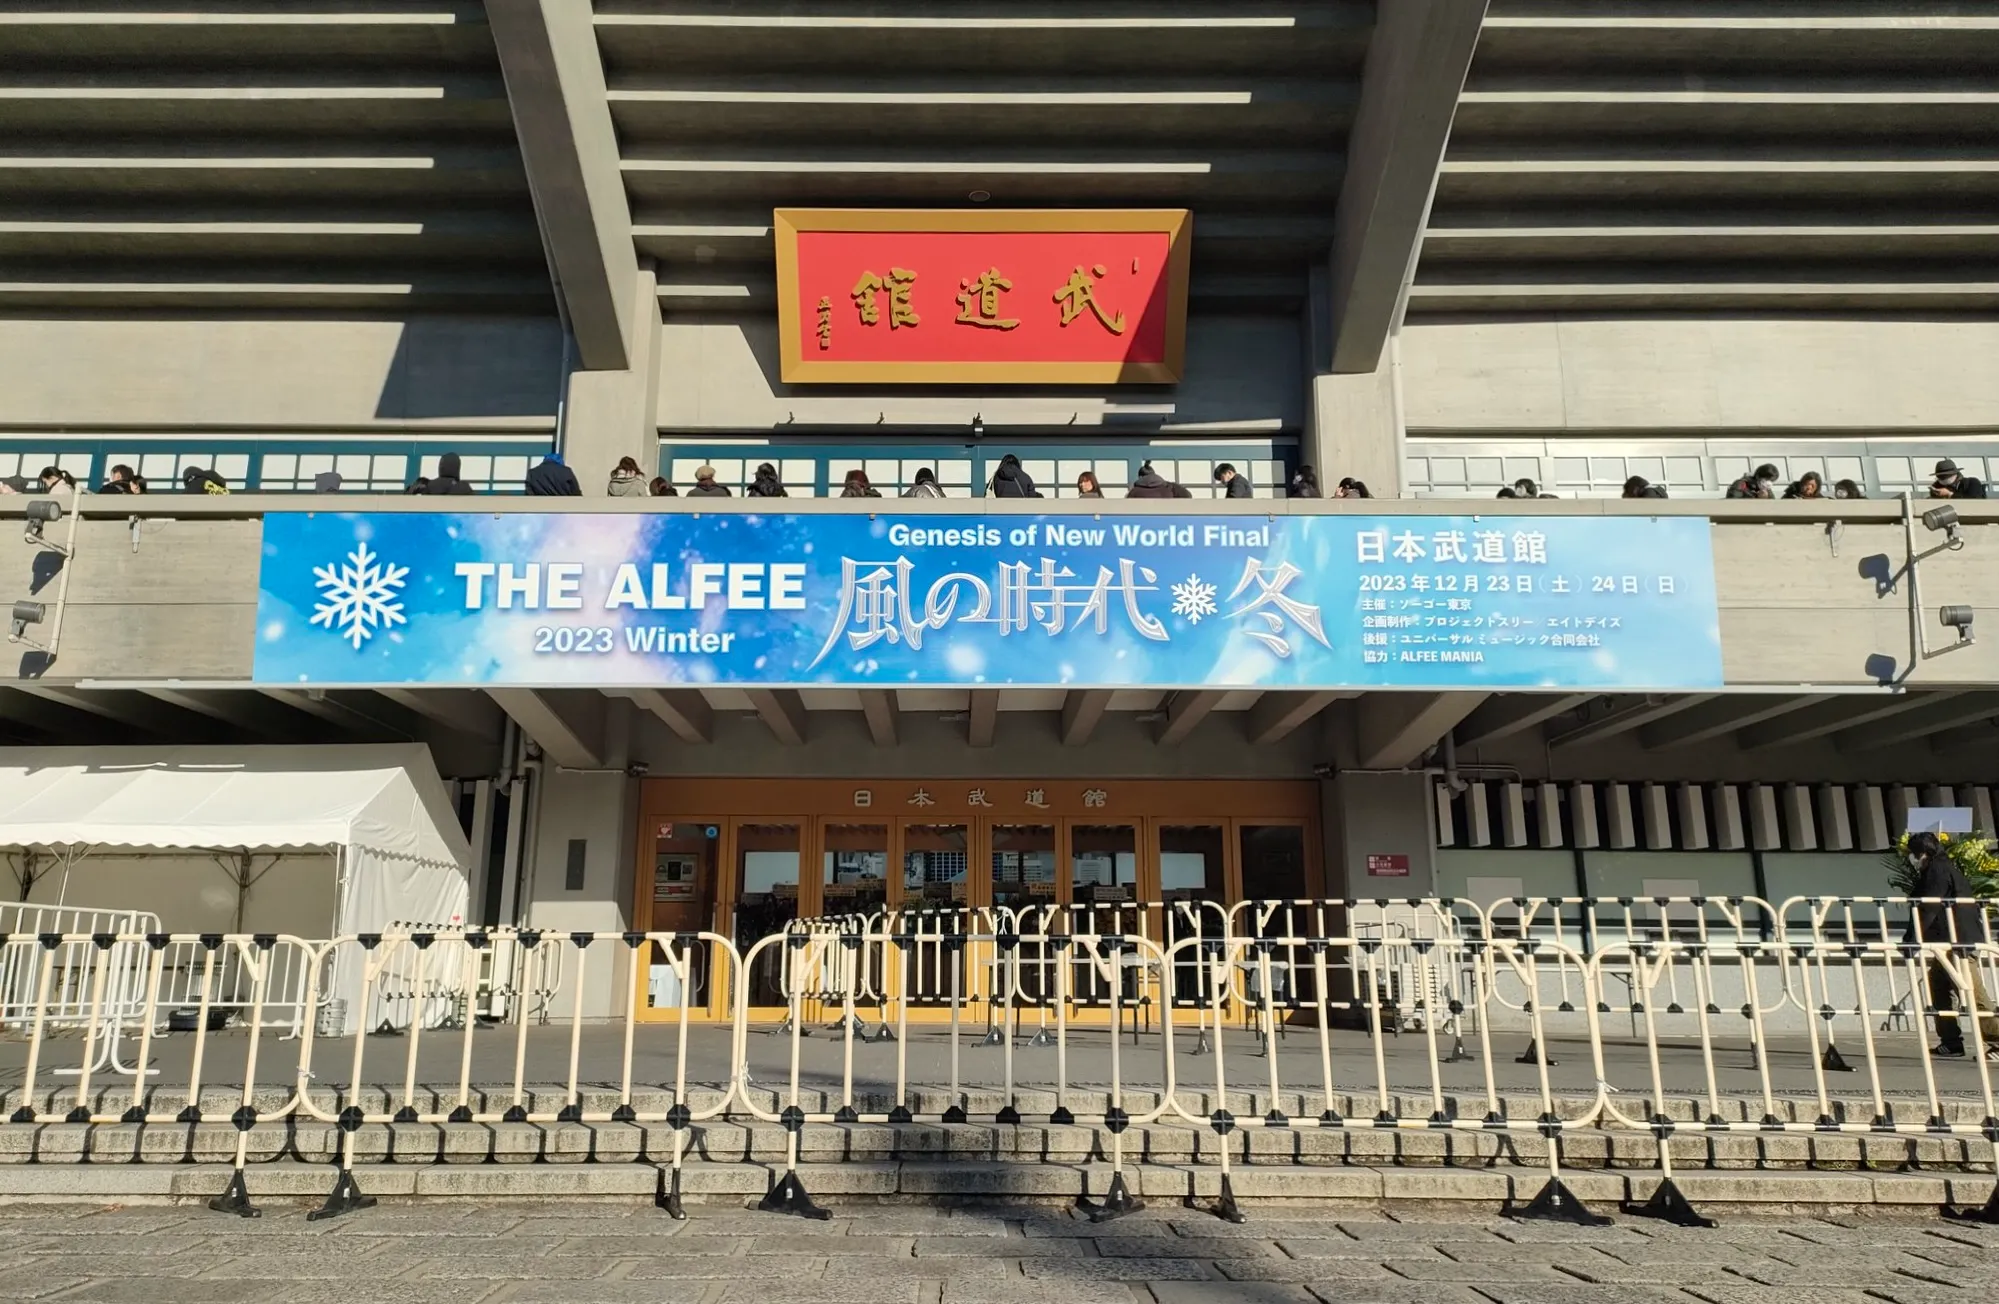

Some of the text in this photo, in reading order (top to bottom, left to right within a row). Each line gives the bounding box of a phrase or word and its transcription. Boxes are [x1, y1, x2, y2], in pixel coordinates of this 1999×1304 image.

[888, 524, 1270, 547] Genesis of New World Final
[1356, 530, 1548, 565] 日本武道館
[454, 563, 807, 611] THE ALFEE
[805, 555, 1334, 672] 風の時代 冬
[534, 626, 736, 654] 2023 Winter
[1440, 651, 1485, 663] MANIA
[853, 788, 1108, 809] 日本武道館
